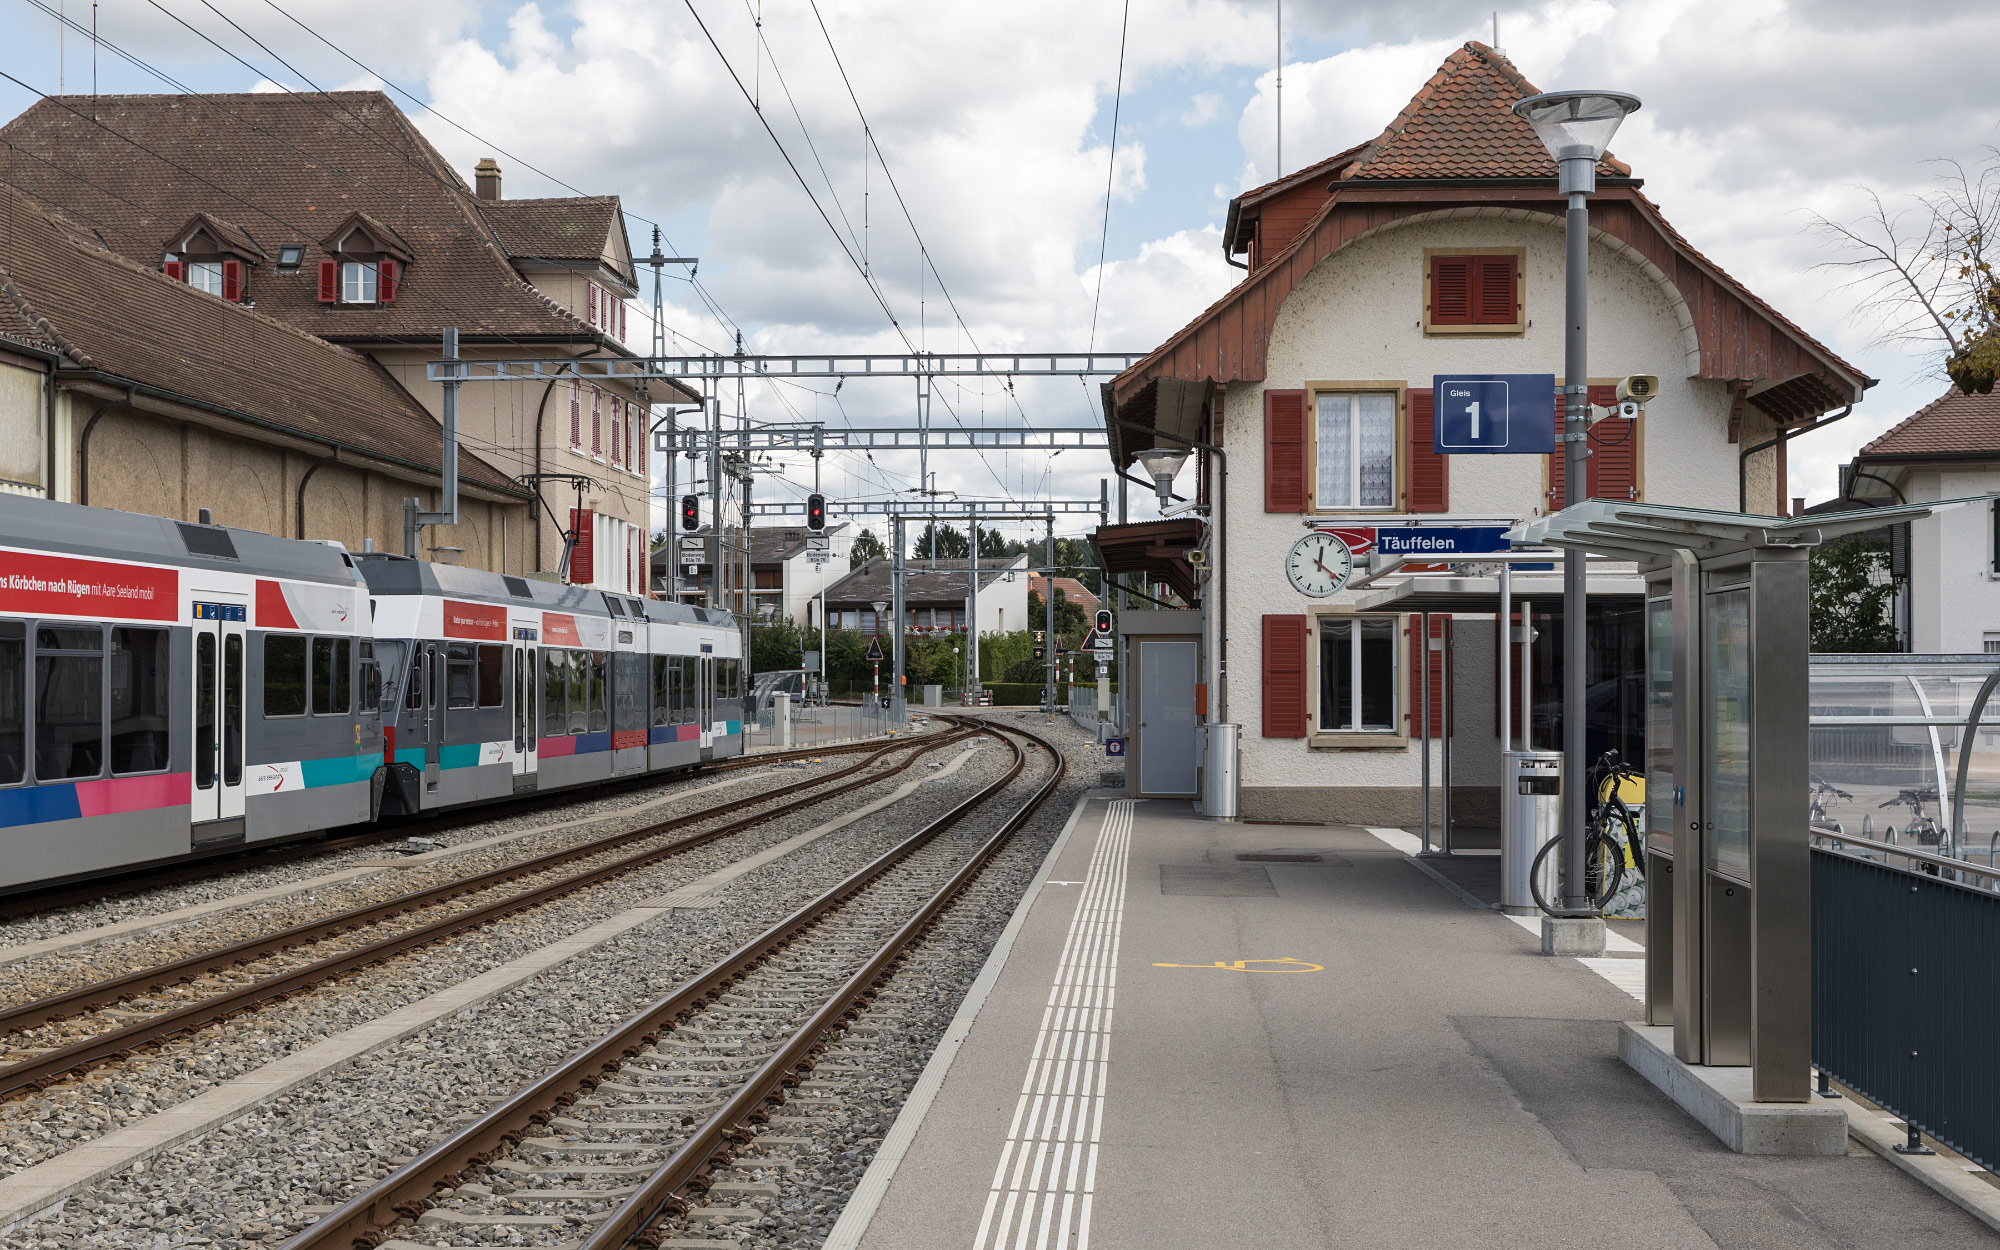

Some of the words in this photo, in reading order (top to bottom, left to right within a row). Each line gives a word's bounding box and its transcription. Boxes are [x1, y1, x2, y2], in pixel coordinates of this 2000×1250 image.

[1450, 389, 1471, 397] Gleis
[1465, 401, 1480, 439] 1
[1381, 536, 1455, 550] Täuffelen
[9, 575, 47, 592] Körbchen
[48, 579, 66, 593] nach
[67, 580, 91, 598] Rügen
[91, 582, 101, 596] mit
[102, 583, 116, 597] Aare
[116, 584, 139, 599] Seeland
[139, 586, 154, 600] mobil
